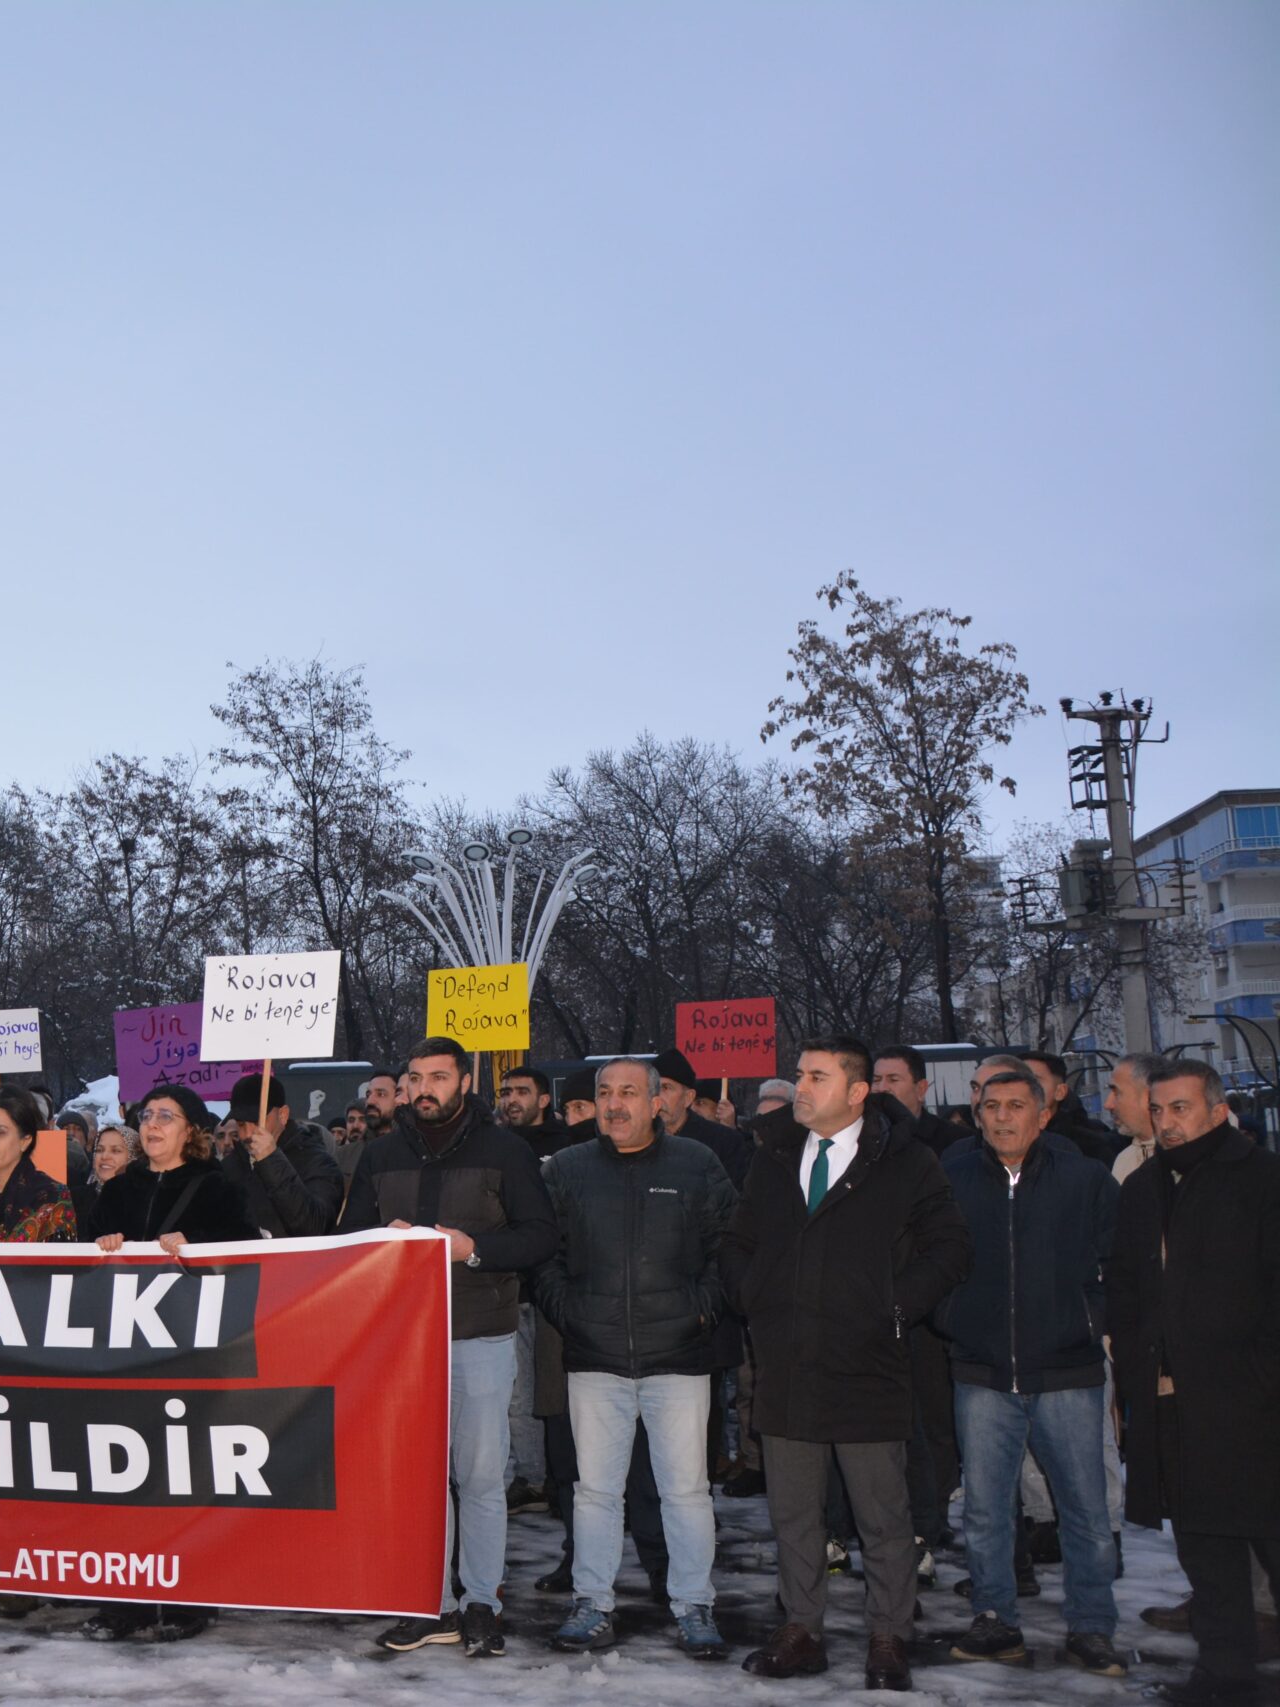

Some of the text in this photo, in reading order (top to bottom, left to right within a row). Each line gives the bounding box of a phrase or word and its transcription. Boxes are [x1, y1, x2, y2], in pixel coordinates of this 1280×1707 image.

[211, 1004, 234, 1023] Ne
[244, 1002, 258, 1021] bi
[692, 1007, 768, 1029] Rojava
[141, 1010, 188, 1042] Jin
[14, 1041, 40, 1060] heye
[141, 1040, 199, 1068] Jiya
[685, 1038, 706, 1053] Ne
[712, 1036, 725, 1052] bi
